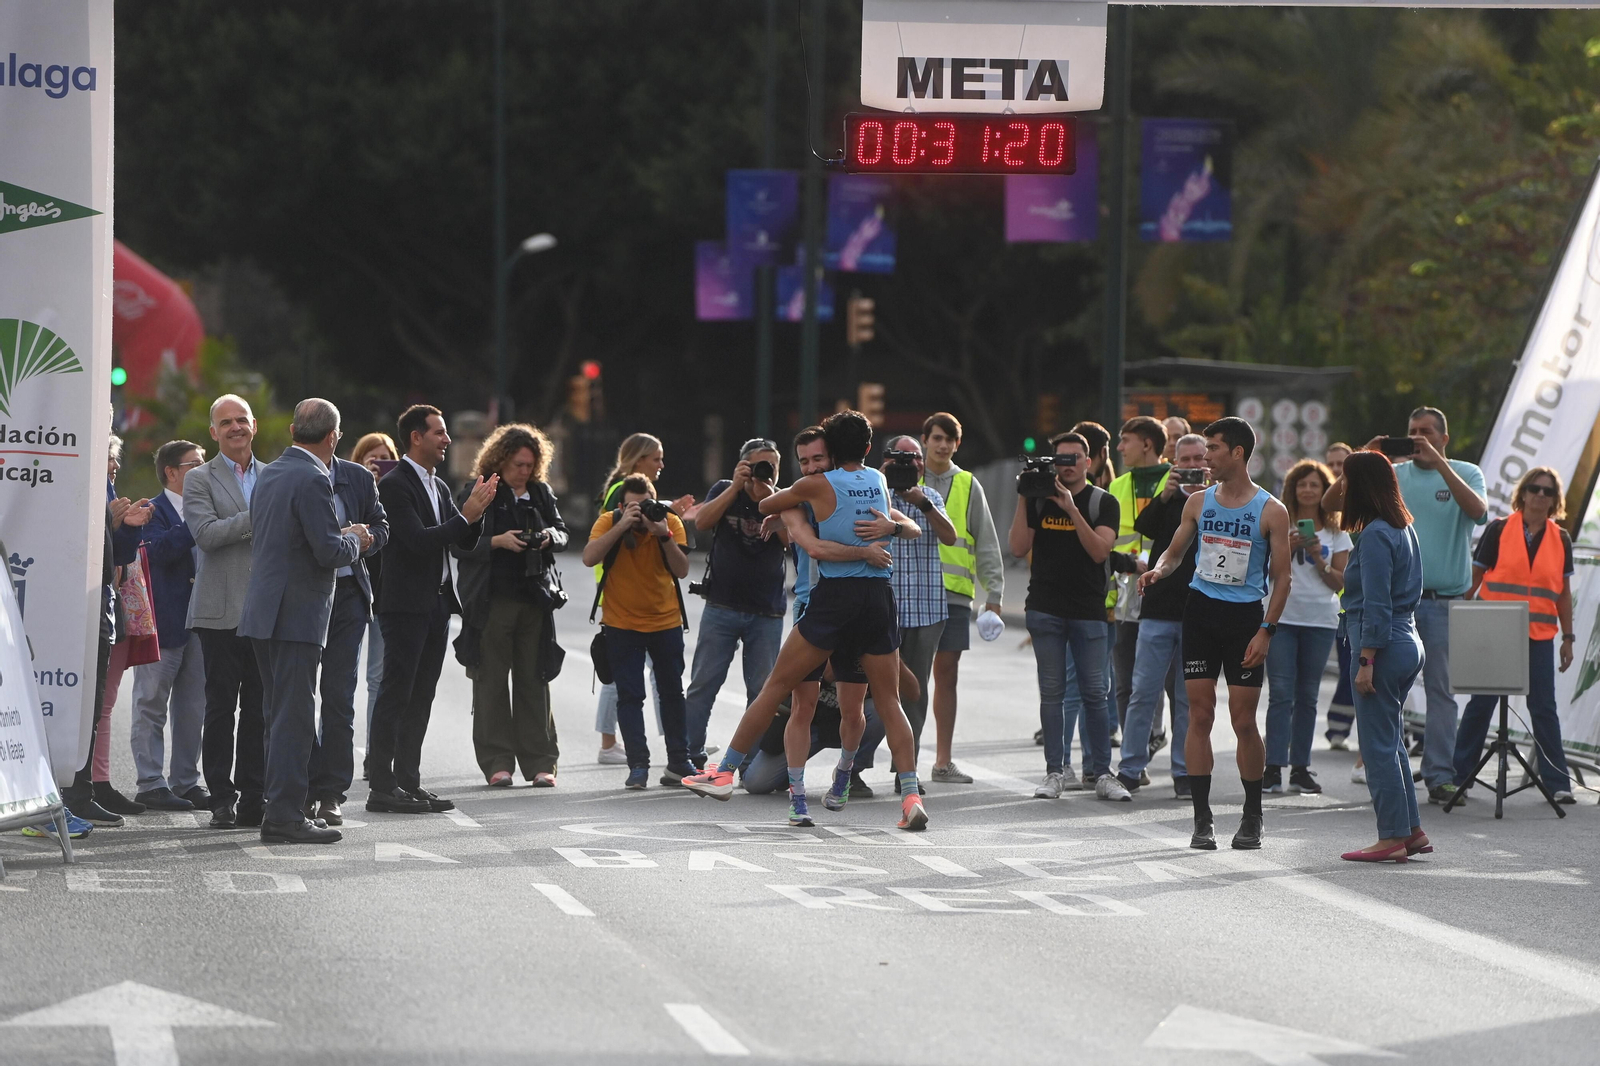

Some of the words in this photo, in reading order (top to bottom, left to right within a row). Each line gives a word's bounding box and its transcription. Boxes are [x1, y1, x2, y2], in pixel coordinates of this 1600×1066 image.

[896, 56, 1069, 102] META
[857, 121, 1065, 166] 00:31:20
[848, 486, 881, 499] nerja
[1203, 518, 1252, 538] nerja
[1216, 555, 1227, 569] 2
[764, 884, 1147, 917] RED
